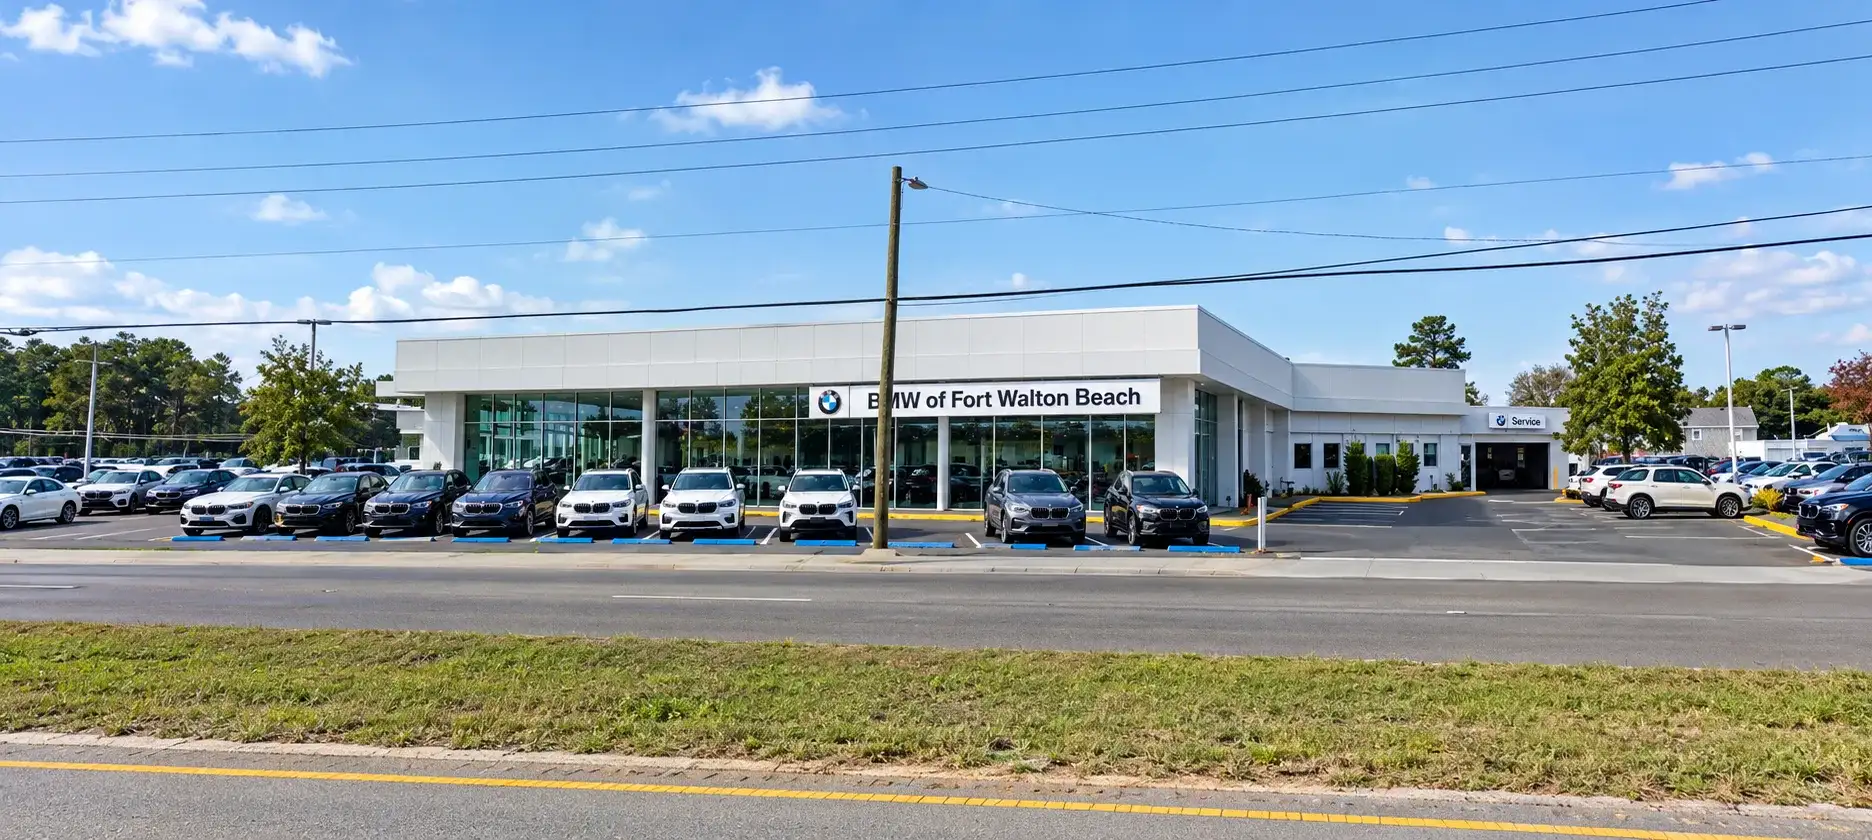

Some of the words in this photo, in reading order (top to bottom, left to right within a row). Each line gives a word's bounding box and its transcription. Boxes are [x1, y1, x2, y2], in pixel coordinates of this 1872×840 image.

[925, 391, 947, 409] of
[951, 390, 993, 408] Fort
[997, 389, 1069, 408] Walton
[1075, 387, 1141, 406] Beach
[1511, 416, 1541, 426] Service
